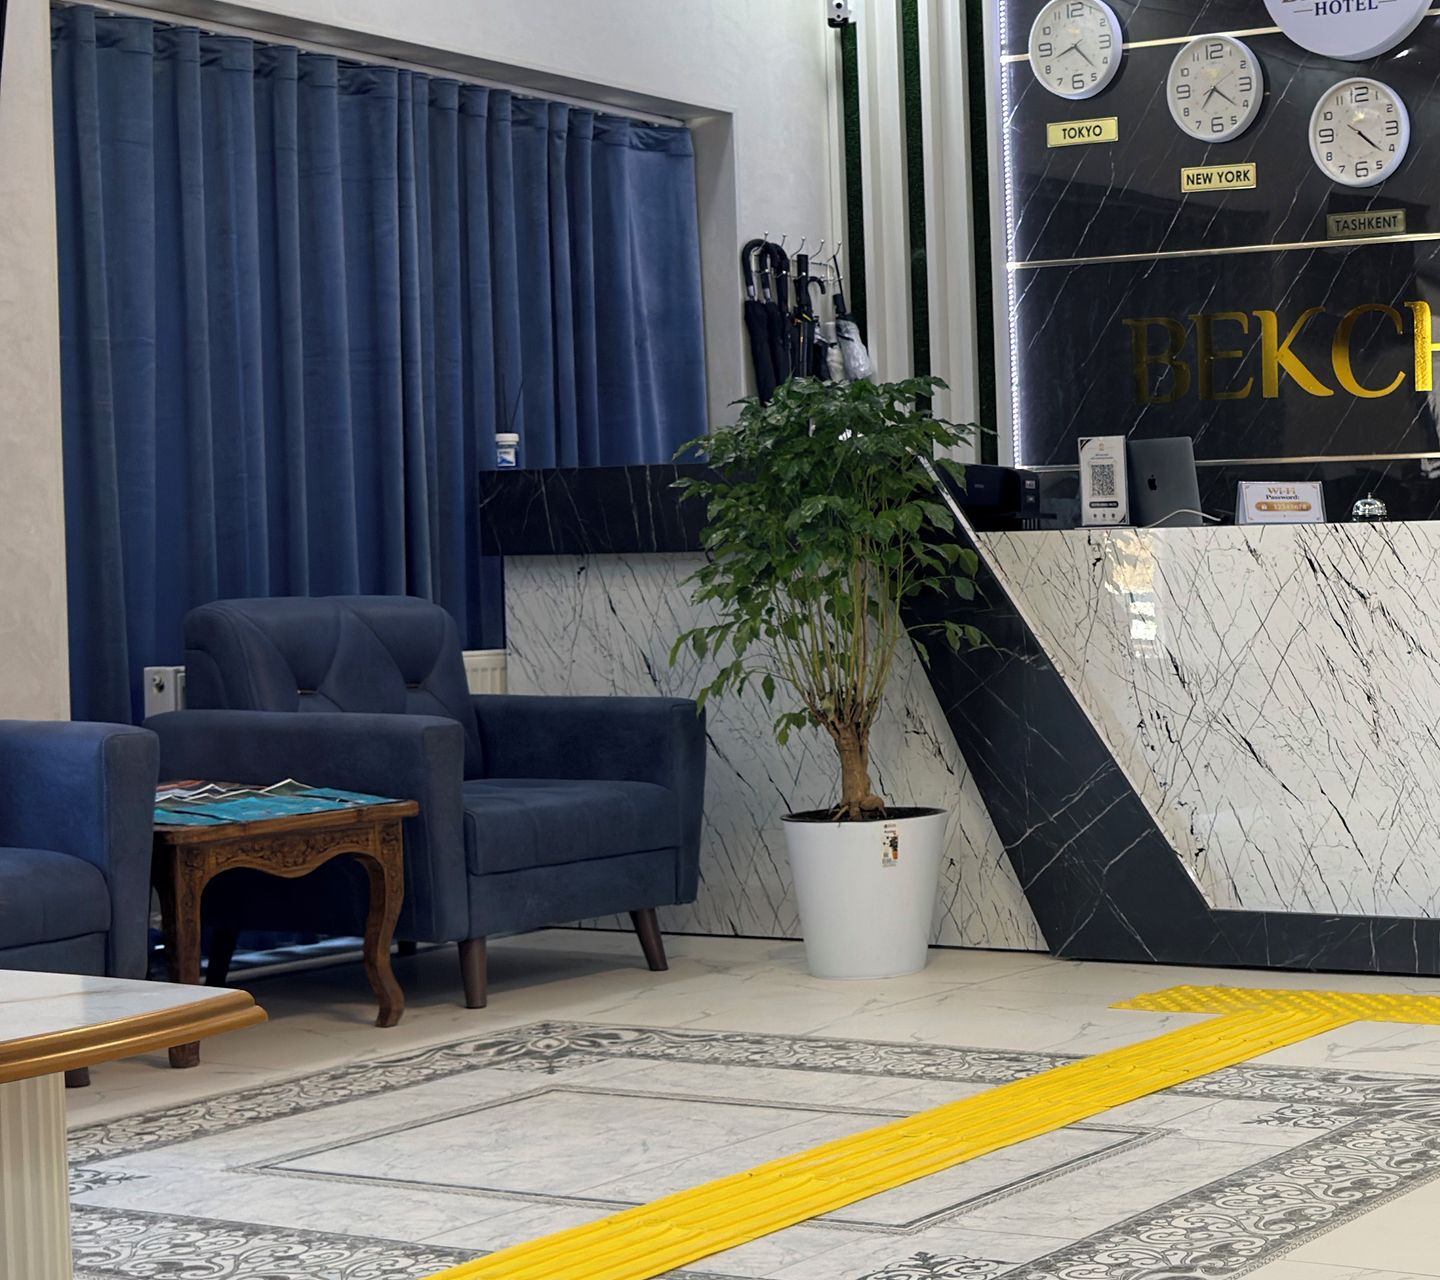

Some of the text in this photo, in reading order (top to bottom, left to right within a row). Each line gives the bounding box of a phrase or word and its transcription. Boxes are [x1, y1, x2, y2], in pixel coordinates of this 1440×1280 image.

[1066, 1, 1084, 19] 12
[1099, 34, 1111, 49] 3
[1038, 42, 1052, 58] 9
[1206, 43, 1224, 60] 12
[1072, 73, 1084, 89] 6
[1239, 77, 1252, 92] 3
[1176, 84, 1191, 100] 9
[1350, 86, 1369, 103] 12
[1062, 125, 1102, 139] TOKYO
[1211, 117, 1224, 133] 6
[1385, 120, 1399, 136] 3
[1319, 128, 1334, 144] 9
[1186, 170, 1250, 185] NEW YORK
[1355, 161, 1369, 178] 6
[1335, 216, 1398, 232] TASHKENT
[1267, 487, 1296, 495] Wi-Fi
